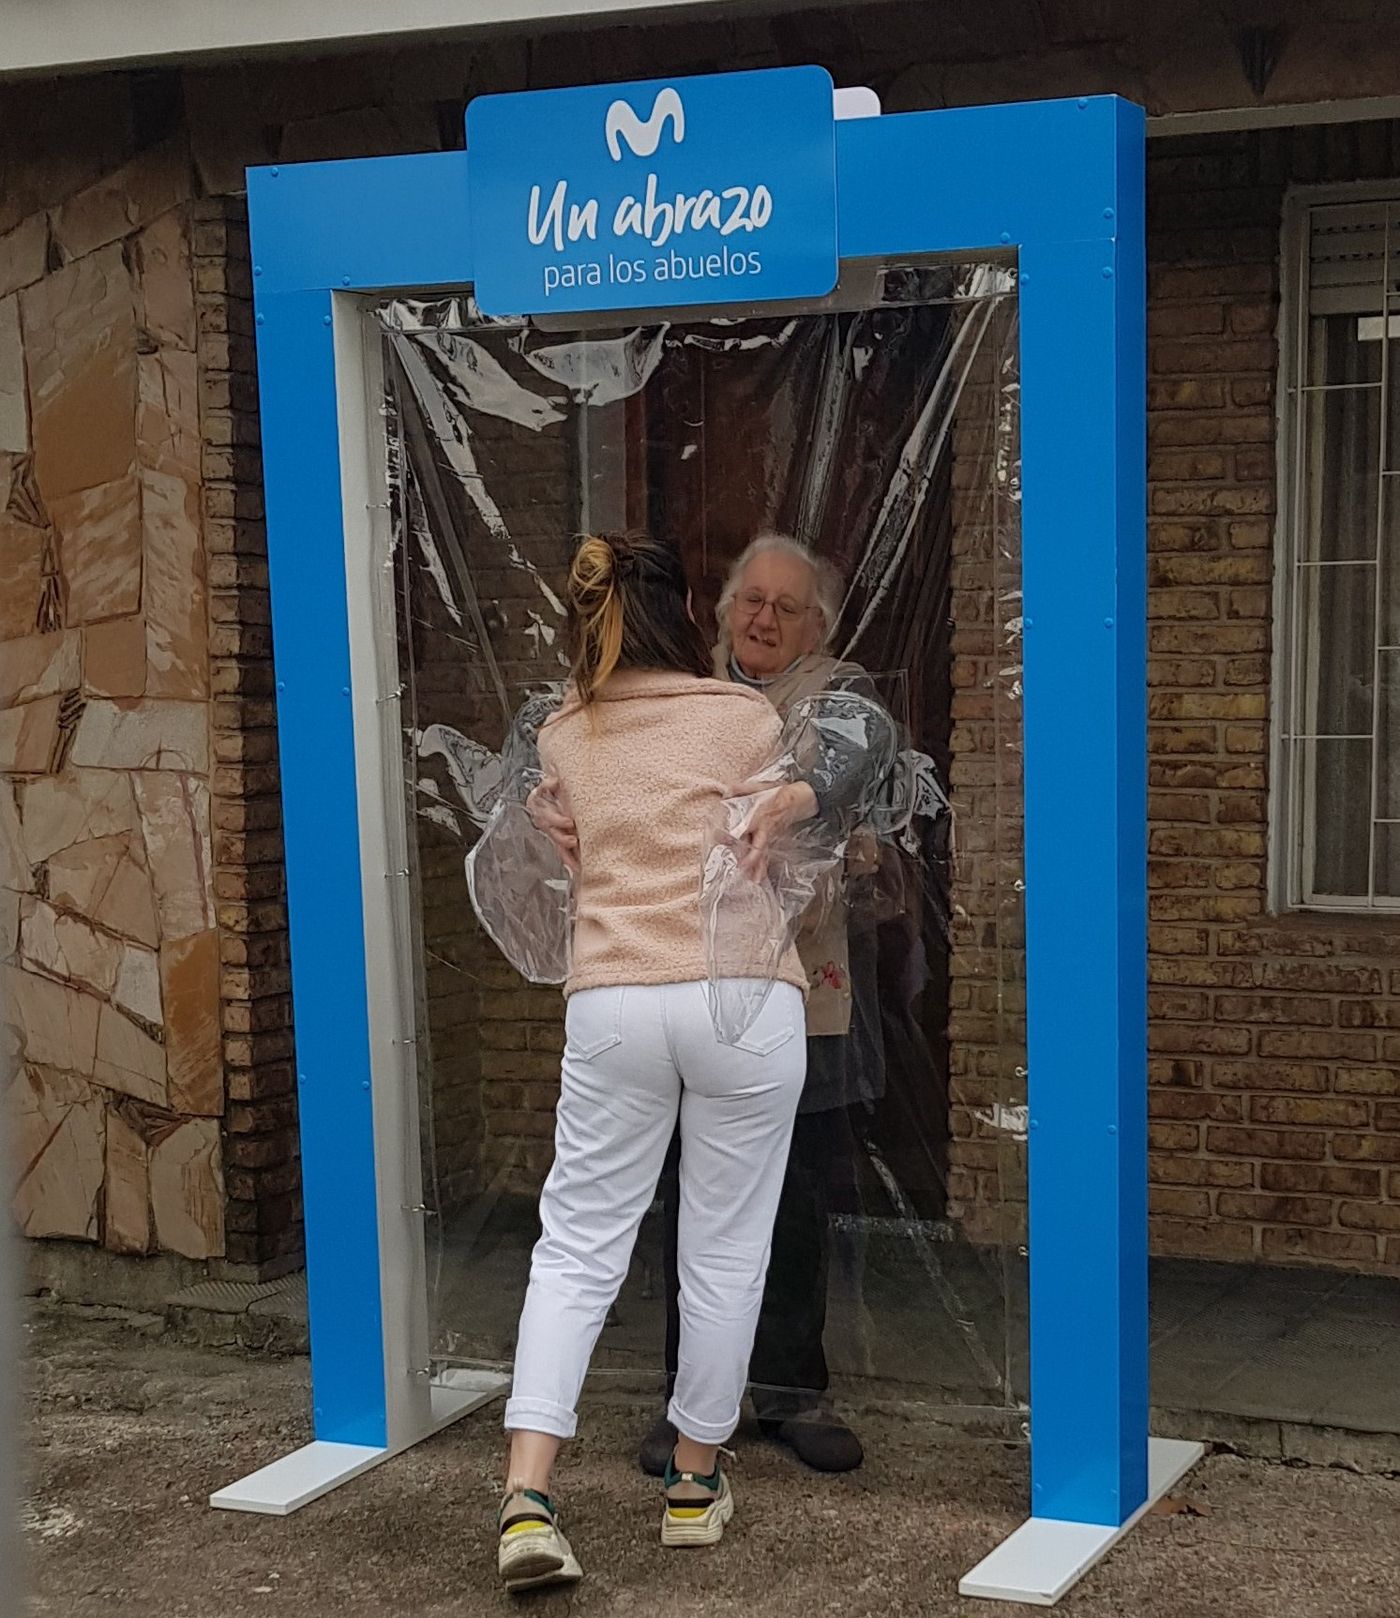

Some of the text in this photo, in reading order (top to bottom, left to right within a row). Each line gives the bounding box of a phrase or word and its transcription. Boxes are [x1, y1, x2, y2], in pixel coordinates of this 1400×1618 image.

[527, 173, 773, 251] Un abrazo
[543, 245, 762, 296] para los abuelos
